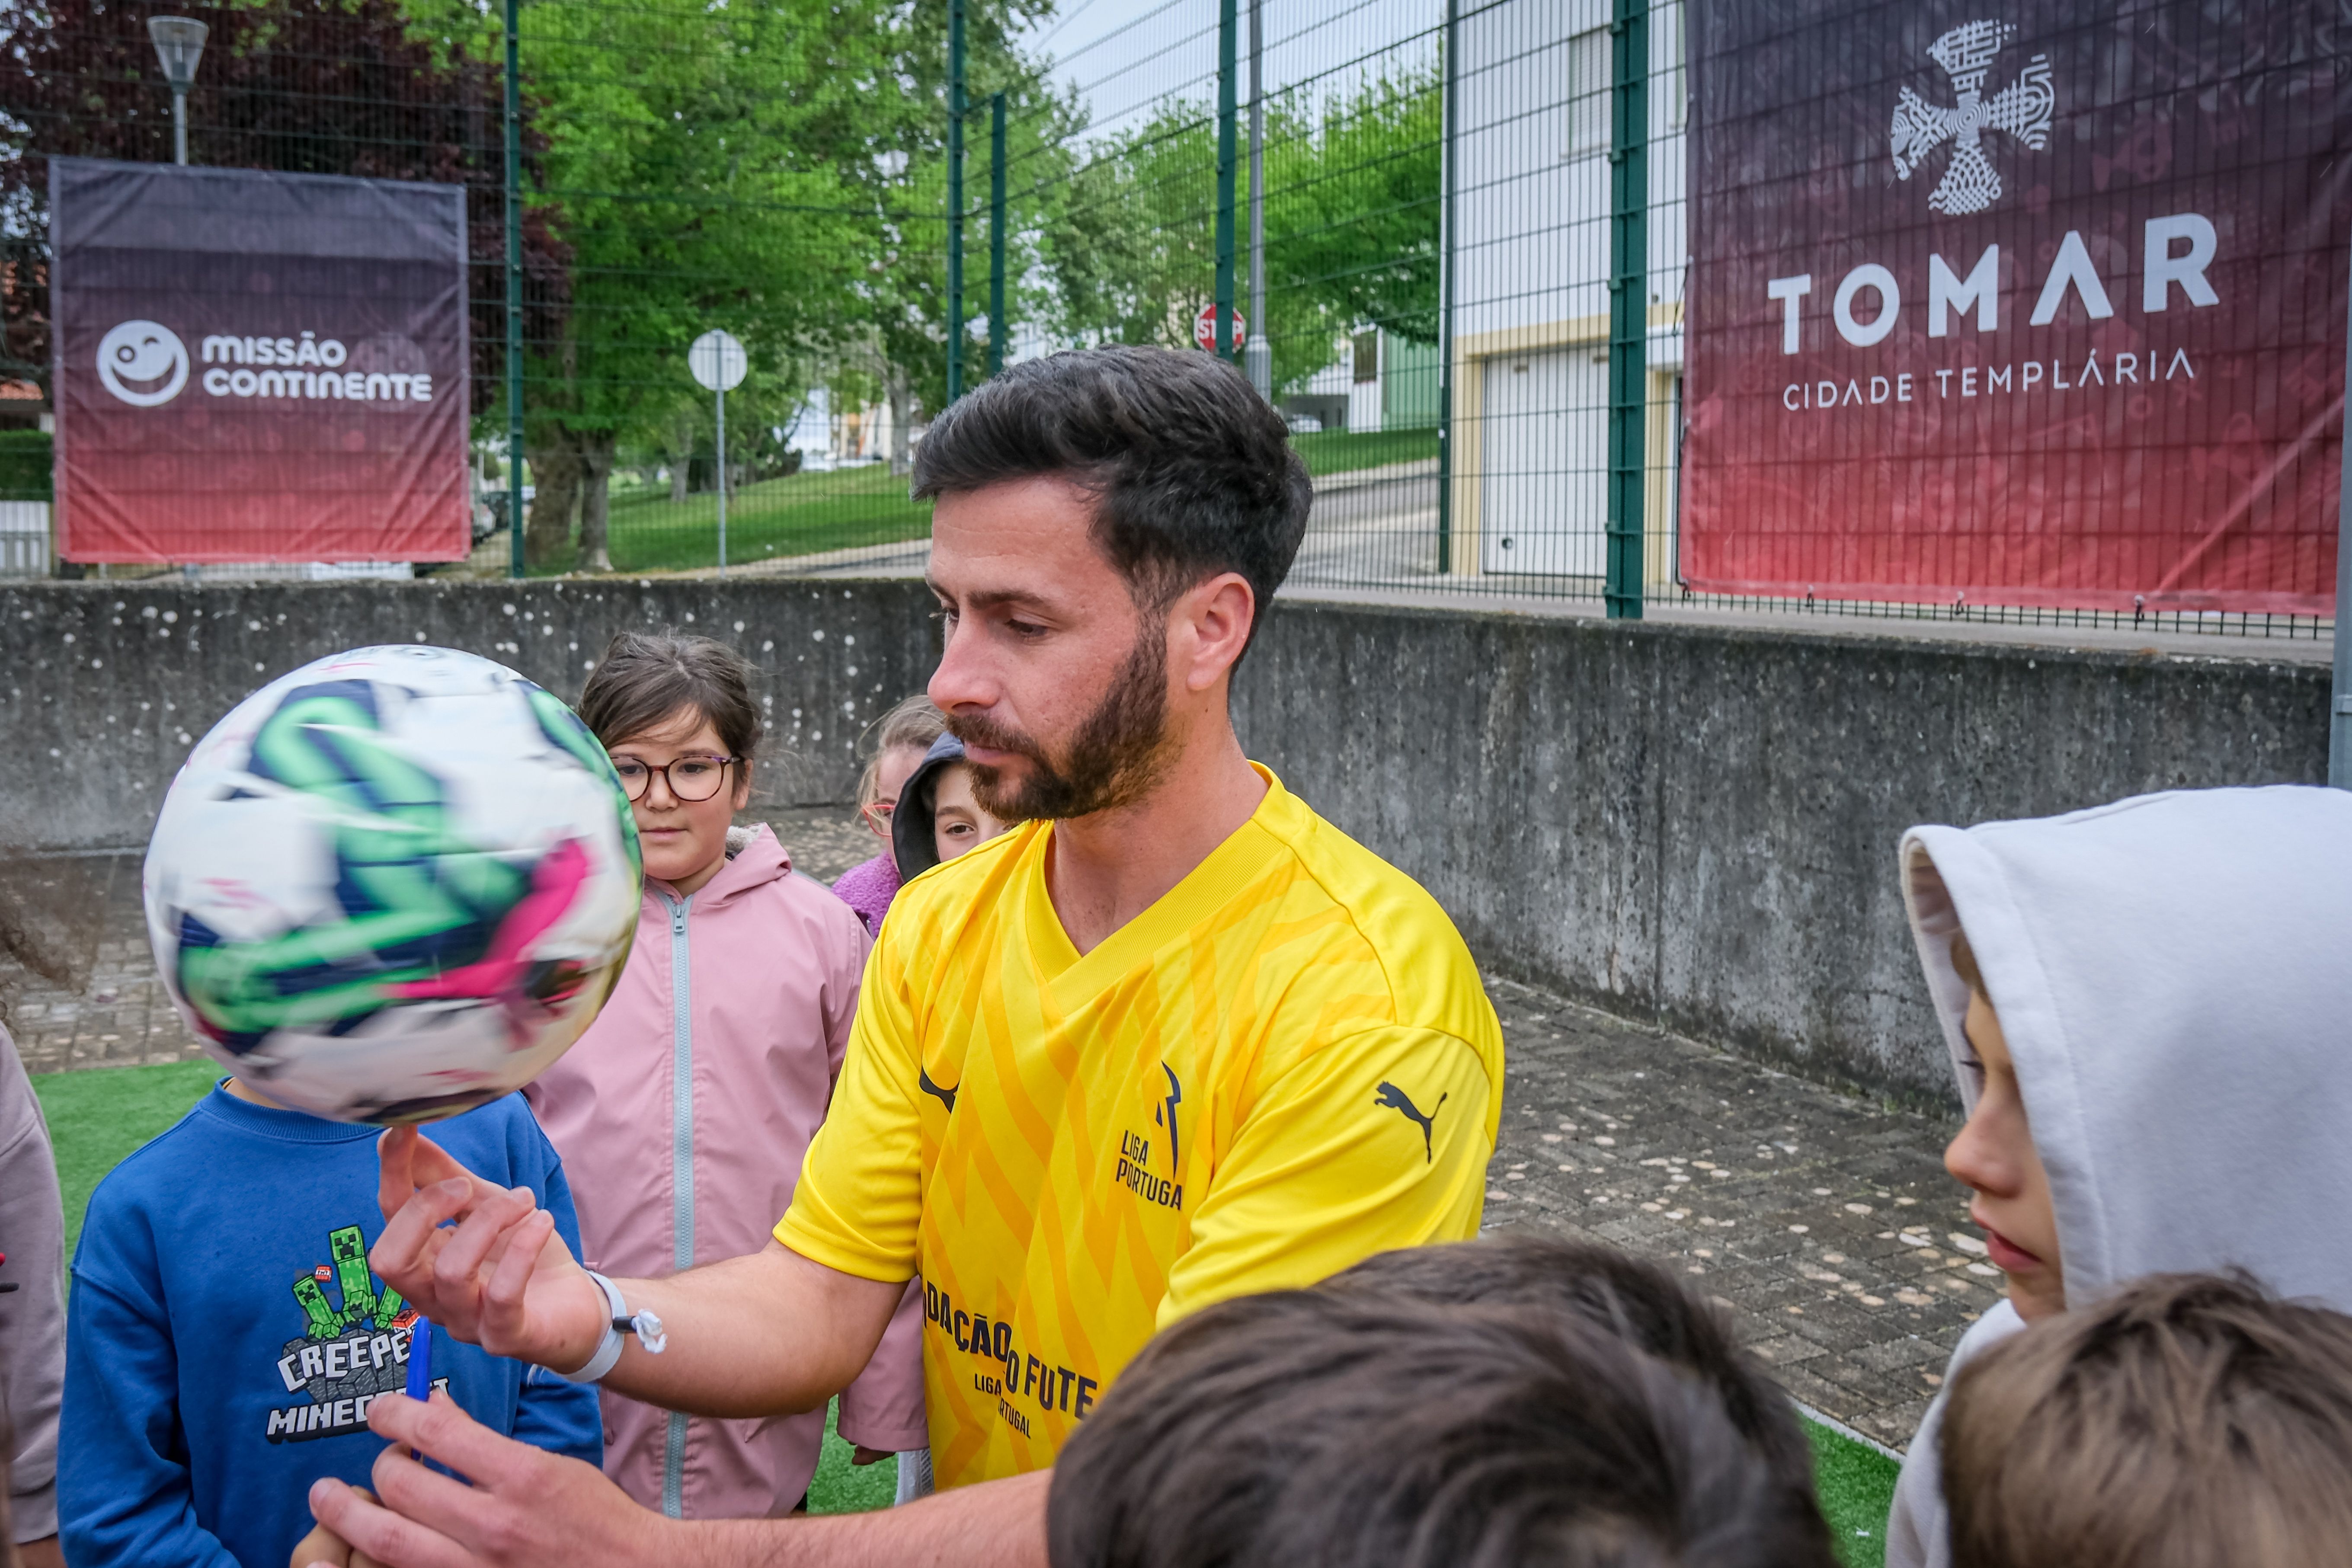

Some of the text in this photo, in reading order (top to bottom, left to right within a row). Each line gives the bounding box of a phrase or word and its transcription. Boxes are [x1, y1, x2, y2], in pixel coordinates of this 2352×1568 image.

[1768, 213, 2219, 355] TOMAR
[202, 330, 347, 368] MISSÃO
[1198, 319, 1243, 341] STP
[202, 367, 432, 402] CONTINENTE
[1783, 347, 2195, 411] CIDADE TEMPLÁRIA
[1121, 1130, 1149, 1166] LIGA
[1116, 1157, 1182, 1211] PORTUGA
[277, 1331, 431, 1392] CREEPE
[923, 1280, 1097, 1420] DAÇÃO O FUTE
[974, 1373, 1002, 1396] LIGA
[998, 1397, 1031, 1440] RTUGAL
